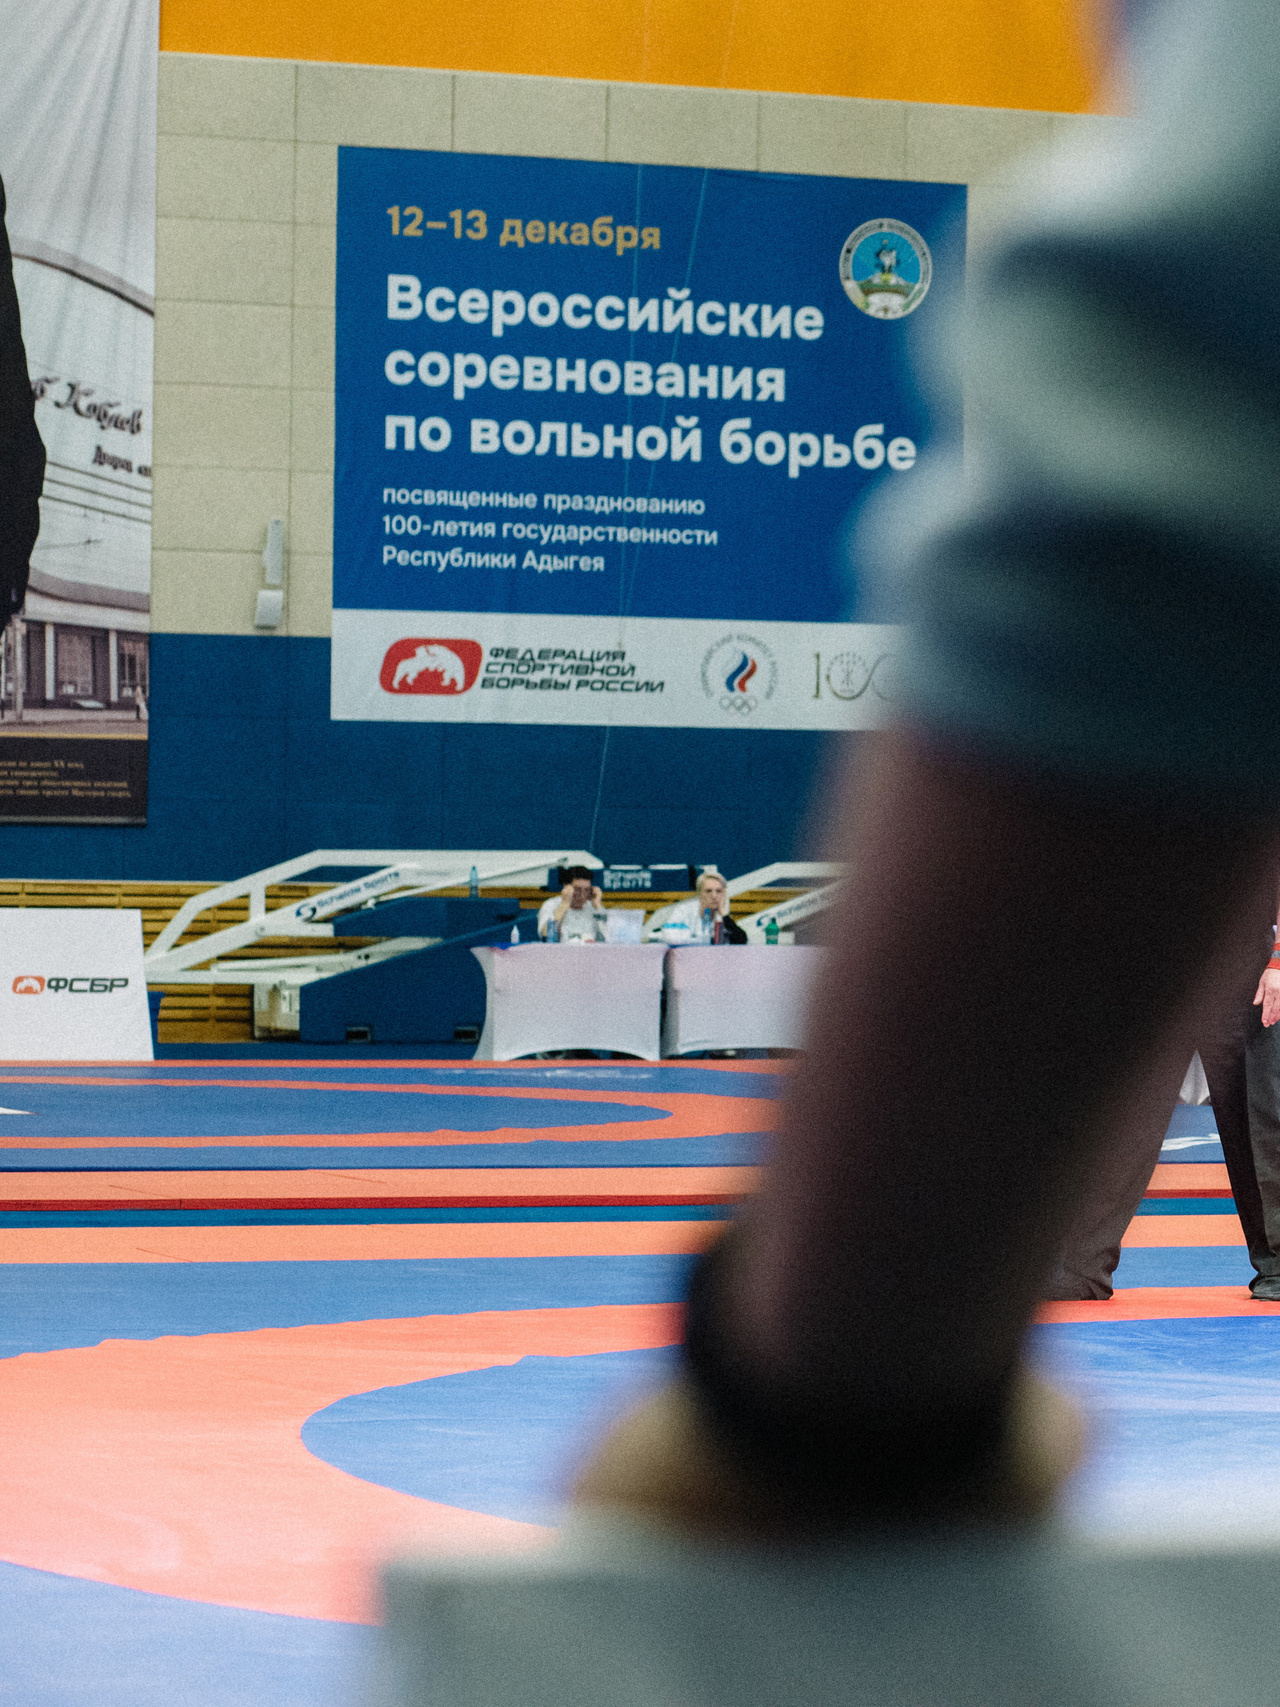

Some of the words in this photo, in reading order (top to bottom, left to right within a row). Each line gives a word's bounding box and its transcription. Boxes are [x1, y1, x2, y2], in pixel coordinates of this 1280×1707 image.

[499, 215, 661, 257] декабря
[386, 274, 825, 340] Всероссийские
[384, 349, 786, 402] соревнования
[384, 414, 453, 452] по
[470, 416, 703, 462] вольной
[719, 417, 917, 479] борьбе
[383, 488, 538, 511] посвященные
[543, 493, 706, 515] празднованию
[383, 515, 496, 538] 100-летия
[502, 521, 718, 546] государственности
[383, 545, 517, 573] Республики
[522, 550, 605, 574] Адыгея
[485, 661, 636, 677] СПОРТИВНОЙ
[489, 647, 626, 663] ФЕДЕРАЦИЯ
[481, 677, 571, 691] БОРЬБЫ
[575, 679, 665, 693] РОССИИ
[47, 977, 129, 993] ФСБР
